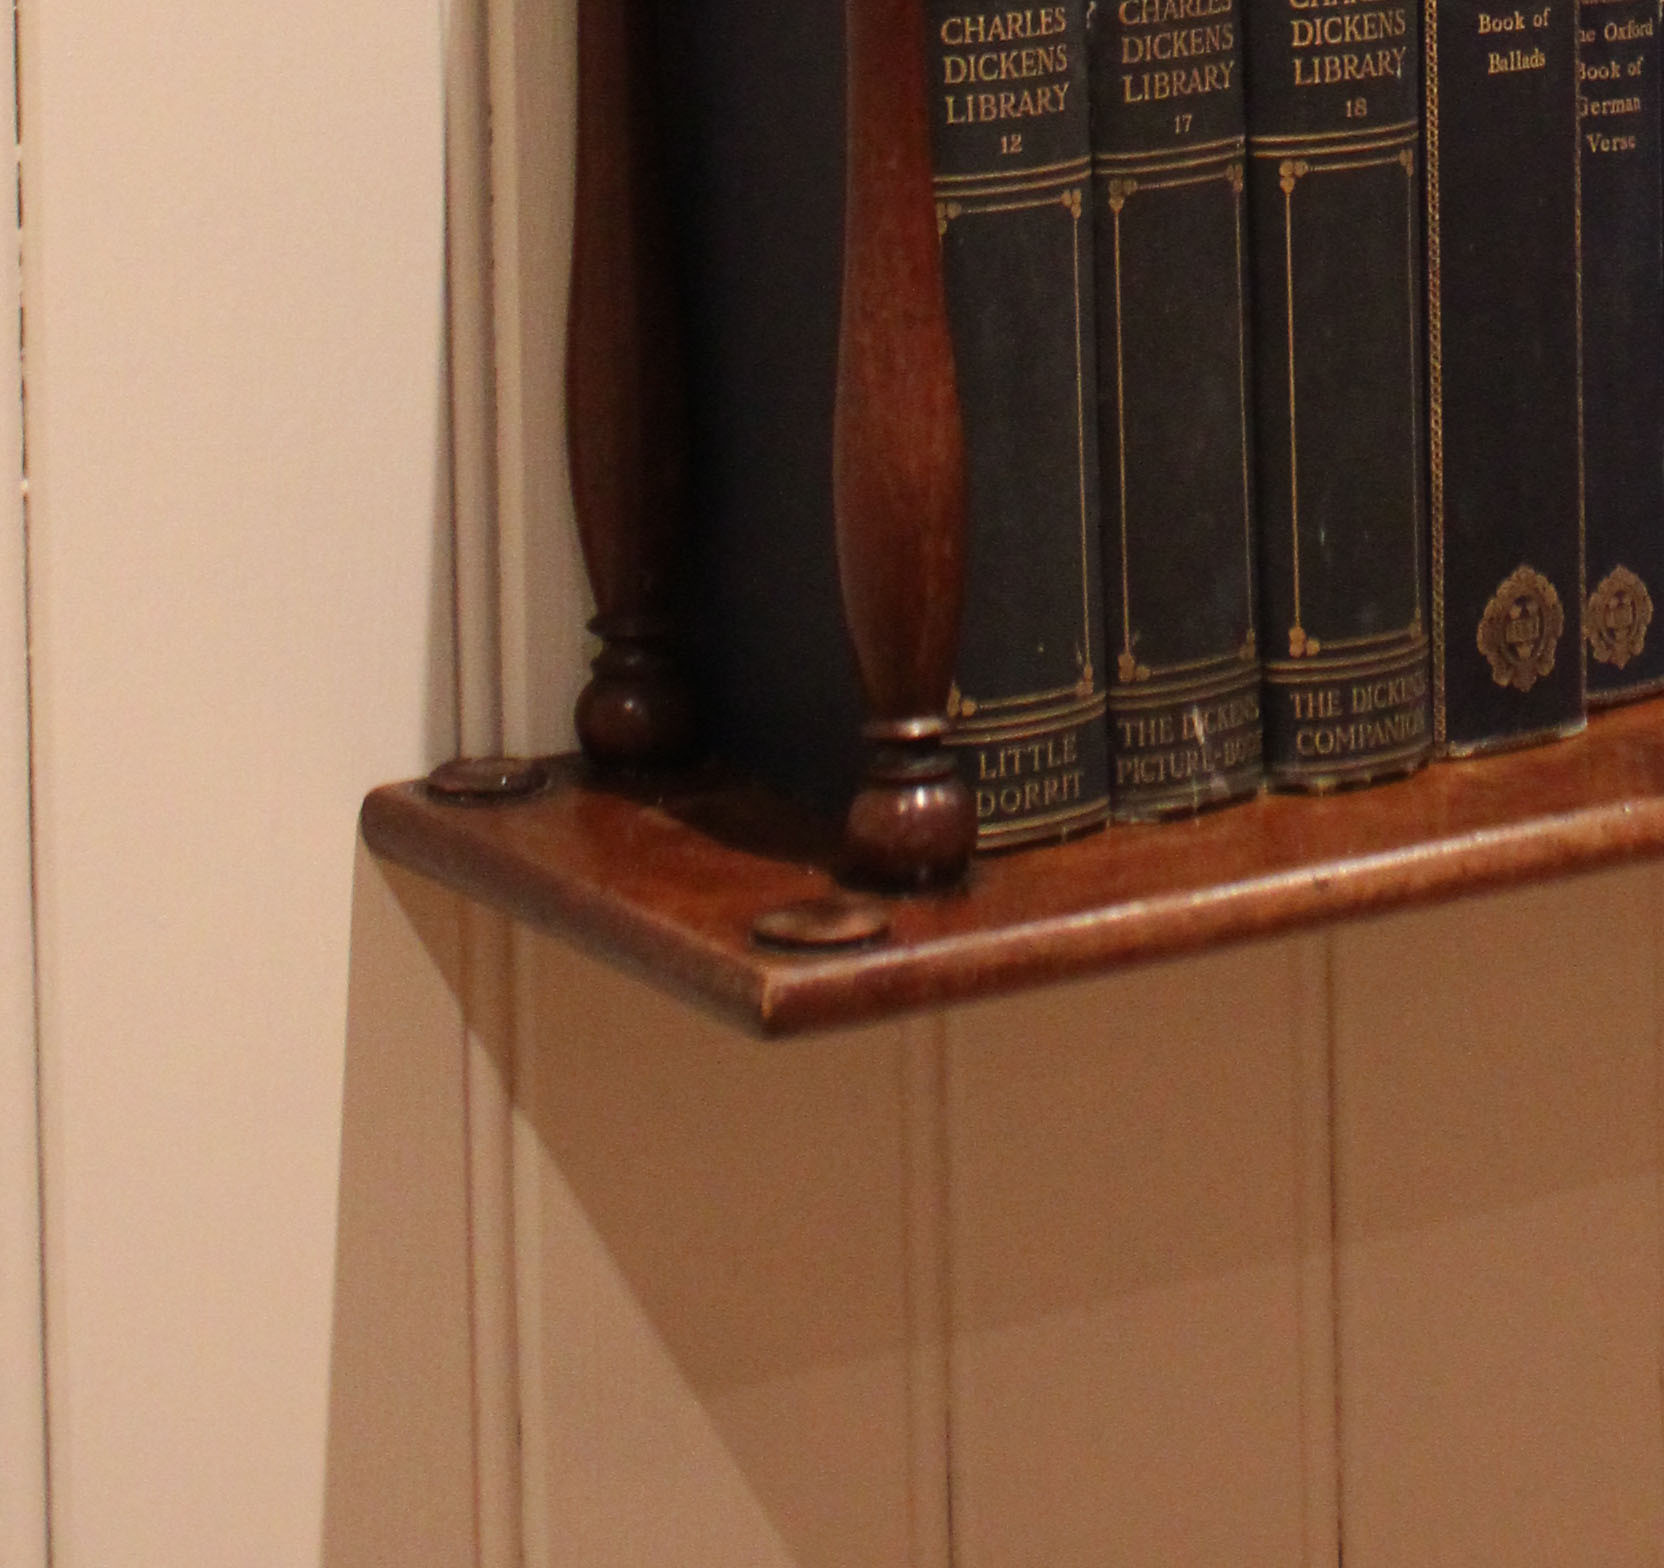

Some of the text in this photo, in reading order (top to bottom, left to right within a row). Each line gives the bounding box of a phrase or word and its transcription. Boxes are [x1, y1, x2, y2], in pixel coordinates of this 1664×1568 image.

[941, 7, 1067, 45] CHARLES
[1291, 9, 1406, 47] DICKENS
[1478, 8, 1551, 34] Book of
[1604, 17, 1653, 42] Oxford
[1121, 24, 1234, 64] DICKENS
[943, 45, 1068, 84] DICKENS
[1294, 47, 1407, 87] LIBRARY
[1487, 51, 1546, 75] Ballads
[1628, 55, 1644, 76] of
[1123, 61, 1235, 104] LIBRARY
[945, 84, 1071, 124] LIBRARY
[1345, 98, 1367, 118] 18
[1174, 115, 1193, 134] 17
[1000, 134, 1023, 154] 12
[1587, 132, 1636, 153] Verse
[1290, 688, 1343, 719] THE
[1116, 717, 1174, 748] THE
[978, 733, 1077, 781] LITTLE
[976, 772, 1082, 819] DORRIT
